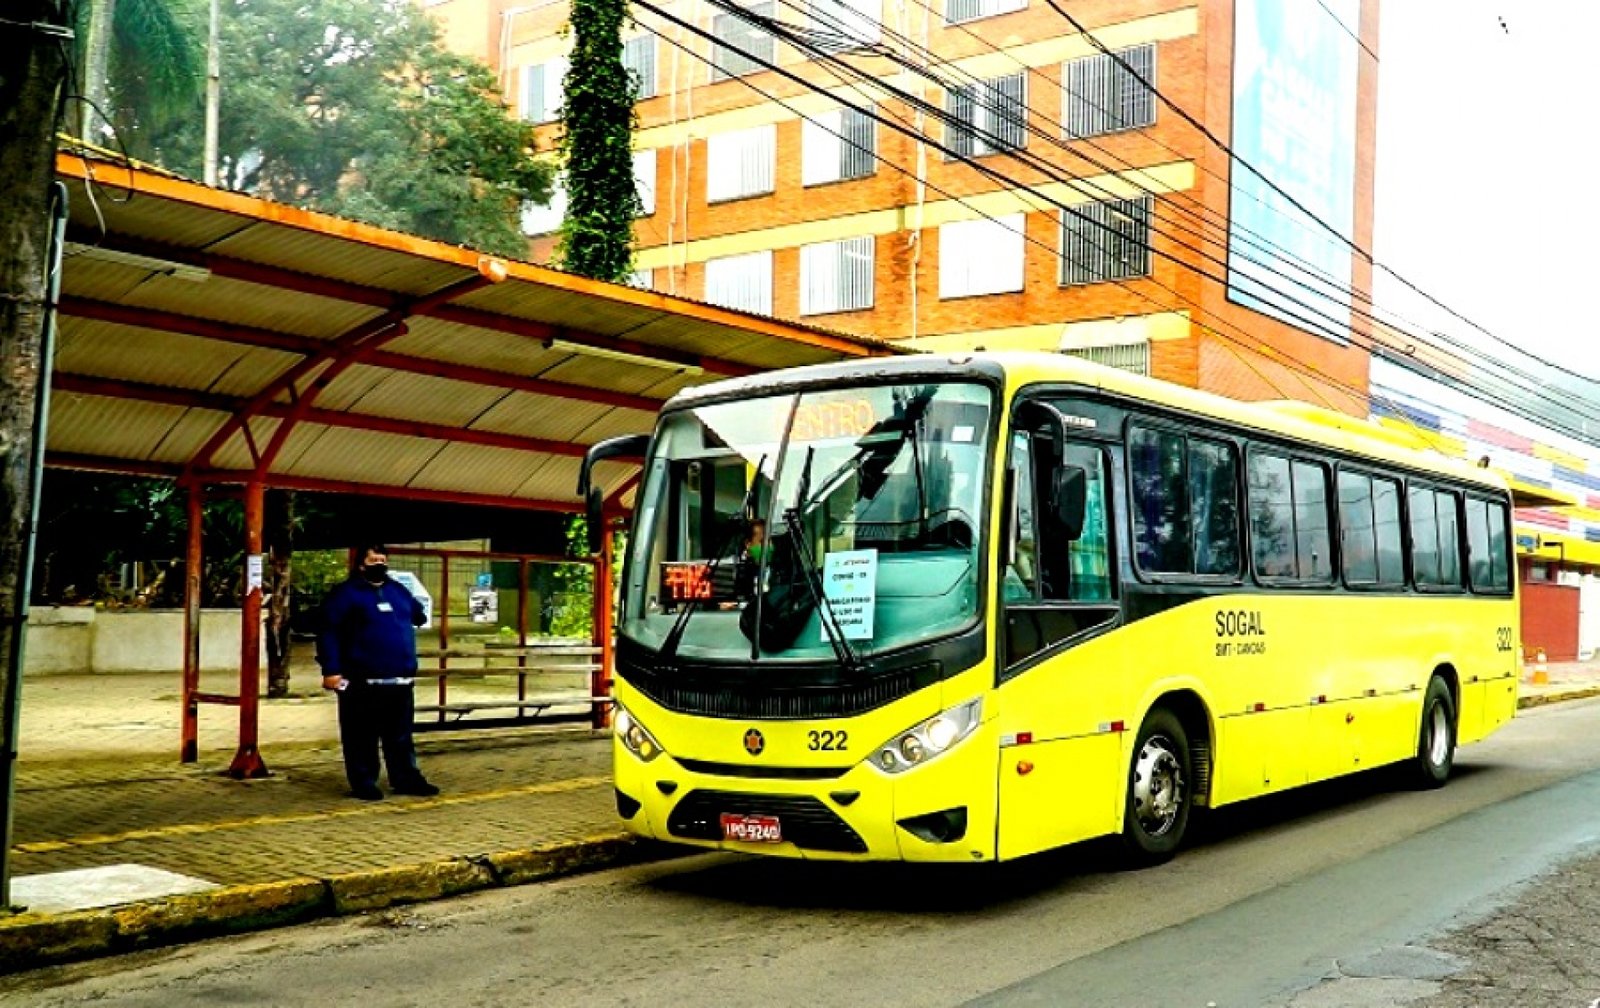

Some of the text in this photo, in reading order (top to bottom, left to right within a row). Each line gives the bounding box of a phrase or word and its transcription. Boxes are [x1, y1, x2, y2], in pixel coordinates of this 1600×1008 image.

[776, 399, 874, 440] ENTRO
[1216, 610, 1265, 637] SOGAL
[1496, 626, 1512, 652] 322
[808, 730, 848, 751] 322
